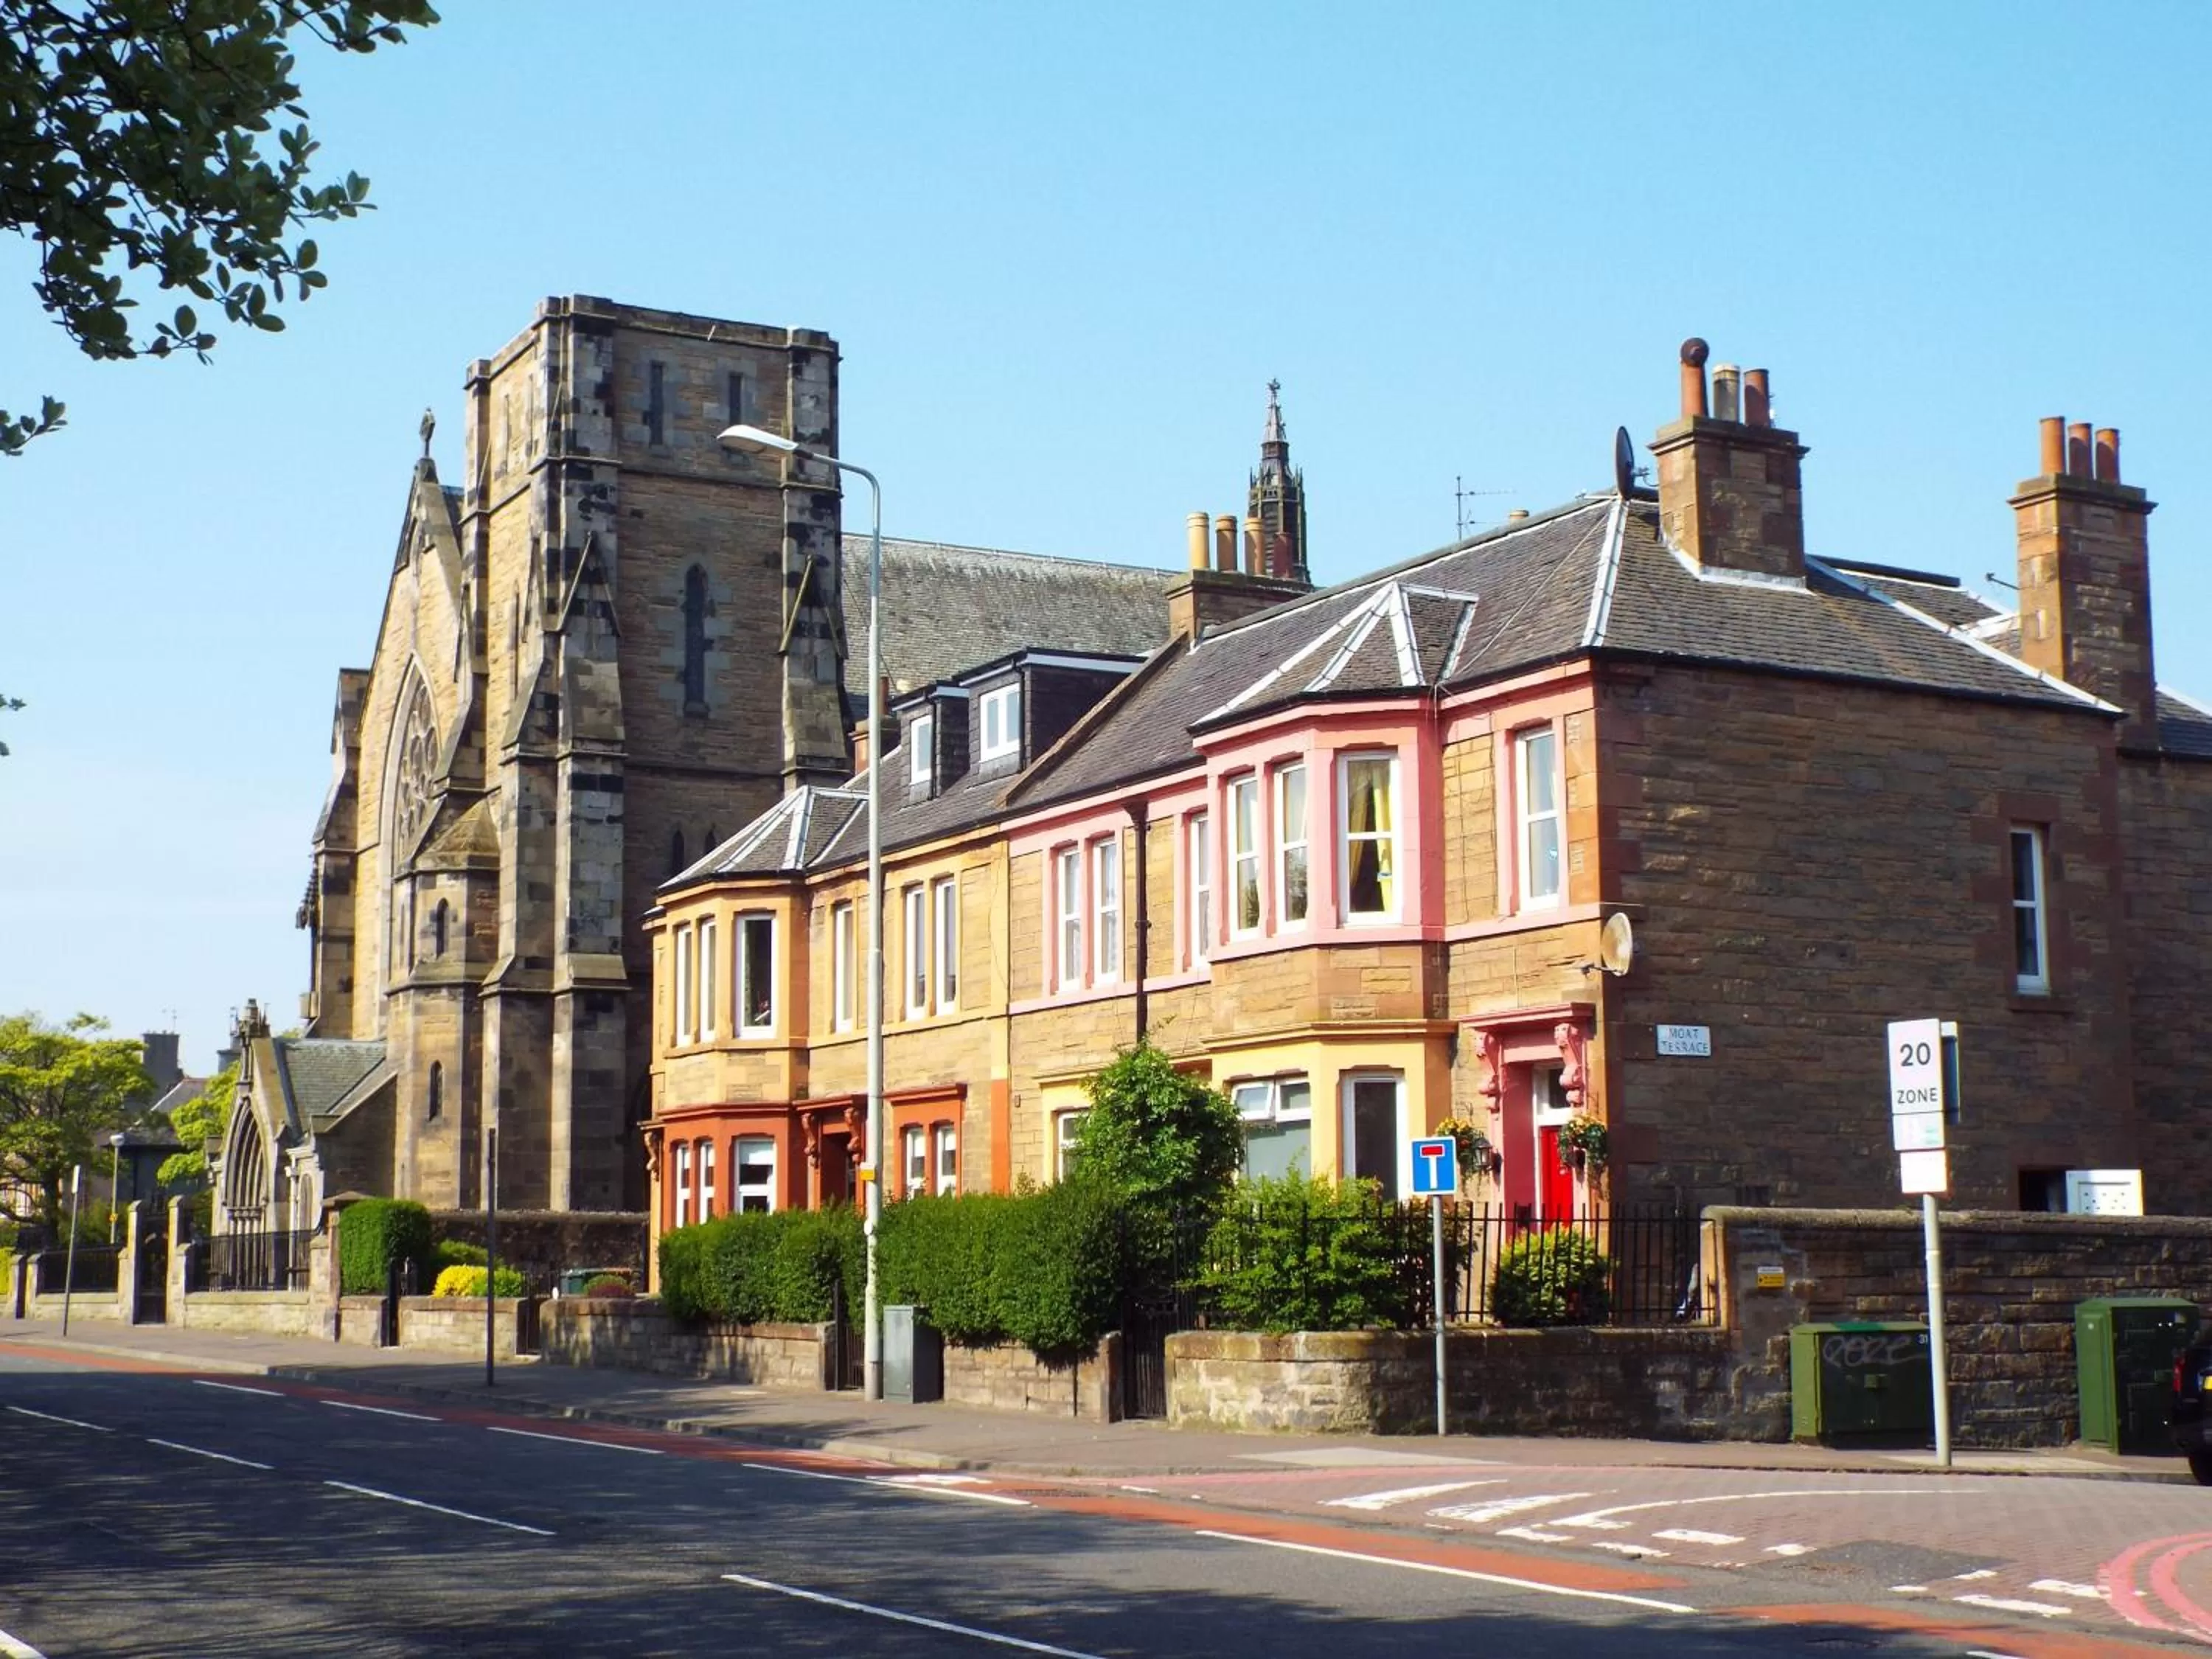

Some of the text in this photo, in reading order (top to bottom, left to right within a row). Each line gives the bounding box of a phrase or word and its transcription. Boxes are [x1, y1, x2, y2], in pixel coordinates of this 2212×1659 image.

[1670, 1028, 1699, 1039] MOAT
[1661, 1040, 1708, 1054] TERRACE
[1900, 1042, 1931, 1067] 20
[1896, 1088, 1938, 1105] ZONE
